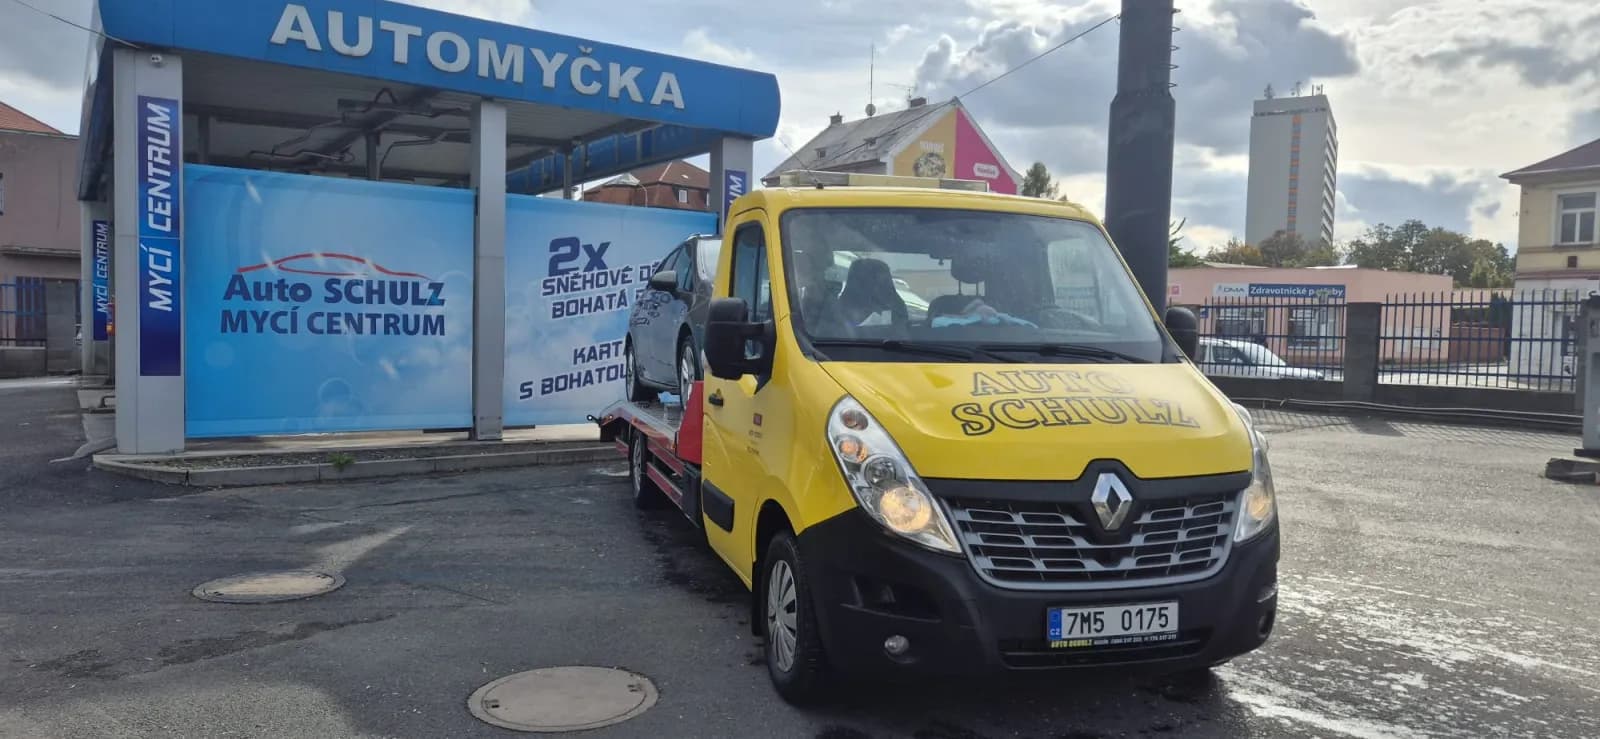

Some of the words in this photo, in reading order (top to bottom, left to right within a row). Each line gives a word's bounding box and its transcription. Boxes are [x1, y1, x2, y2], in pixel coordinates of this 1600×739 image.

[269, 3, 686, 109] AUTOMYČKA
[147, 102, 172, 233] CENTRUM
[96, 223, 109, 280] CENTRUM
[549, 236, 611, 277] 2x
[140, 242, 172, 312] MYCÍ
[223, 274, 312, 303] Auto
[324, 278, 446, 306] SCHULZ
[542, 265, 633, 296] SNĚHOVÉ
[1250, 286, 1307, 295] Zdravotnické
[92, 282, 109, 314] MYCÍ
[552, 289, 628, 319] BOHATÁ
[220, 306, 298, 334] MYCÍ
[306, 312, 445, 336] CENTRUM
[573, 341, 626, 365] KART
[519, 381, 533, 400] S
[971, 370, 1136, 396] AUTO
[951, 396, 1200, 436] SCHULZ
[1050, 628, 1061, 636] CZ
[1067, 611, 1105, 636] 7M5
[1121, 607, 1169, 631] 0175
